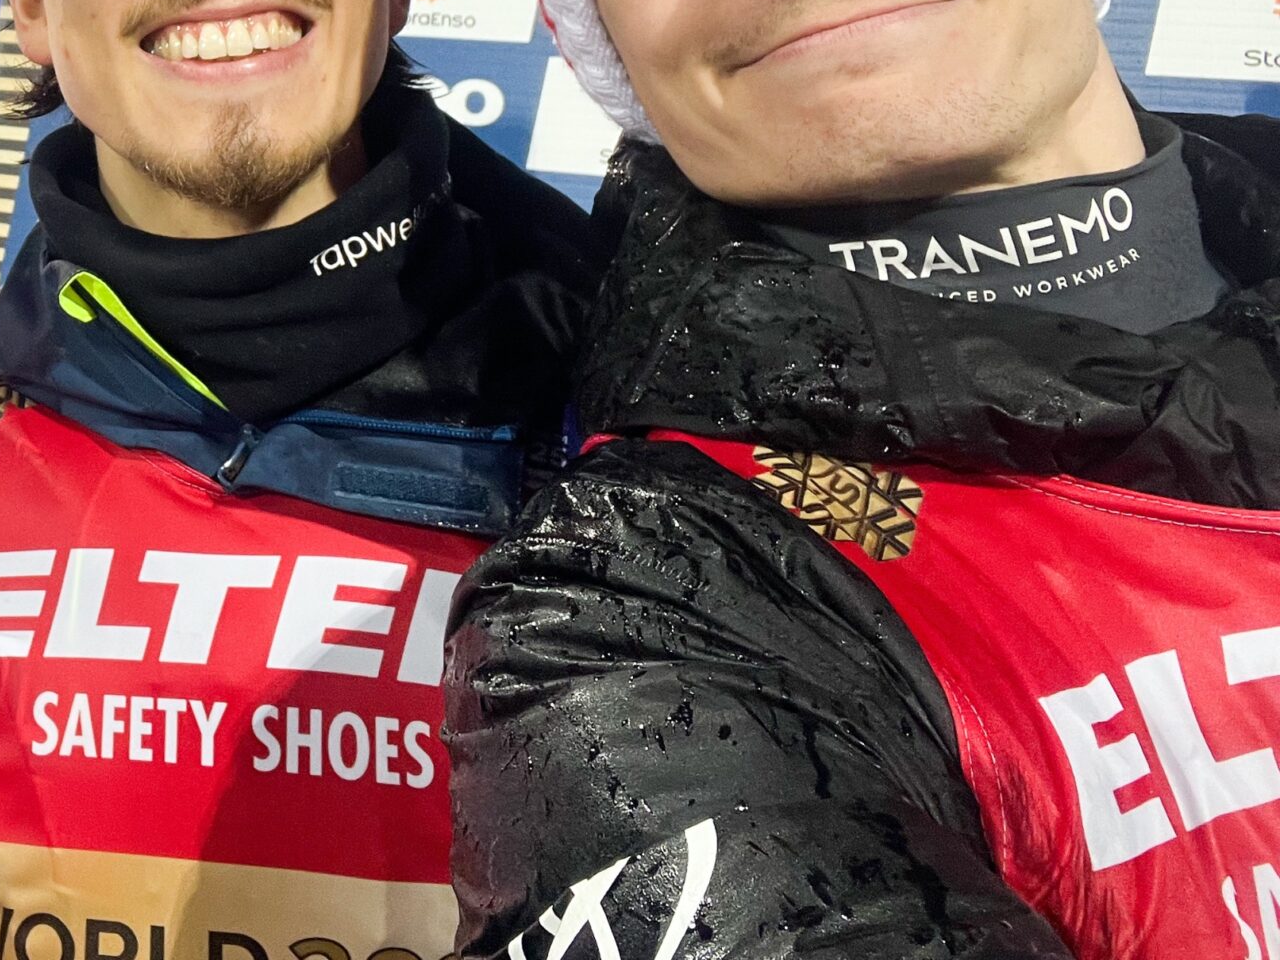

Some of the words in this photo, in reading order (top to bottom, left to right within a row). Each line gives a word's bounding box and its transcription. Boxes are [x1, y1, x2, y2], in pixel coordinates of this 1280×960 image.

[310, 218, 414, 276] Tapwe
[829, 187, 1133, 283] TRANEMO
[1013, 248, 1141, 298] WORKWEAR
[31, 691, 226, 767] SAFETY
[251, 704, 436, 789] SHOES
